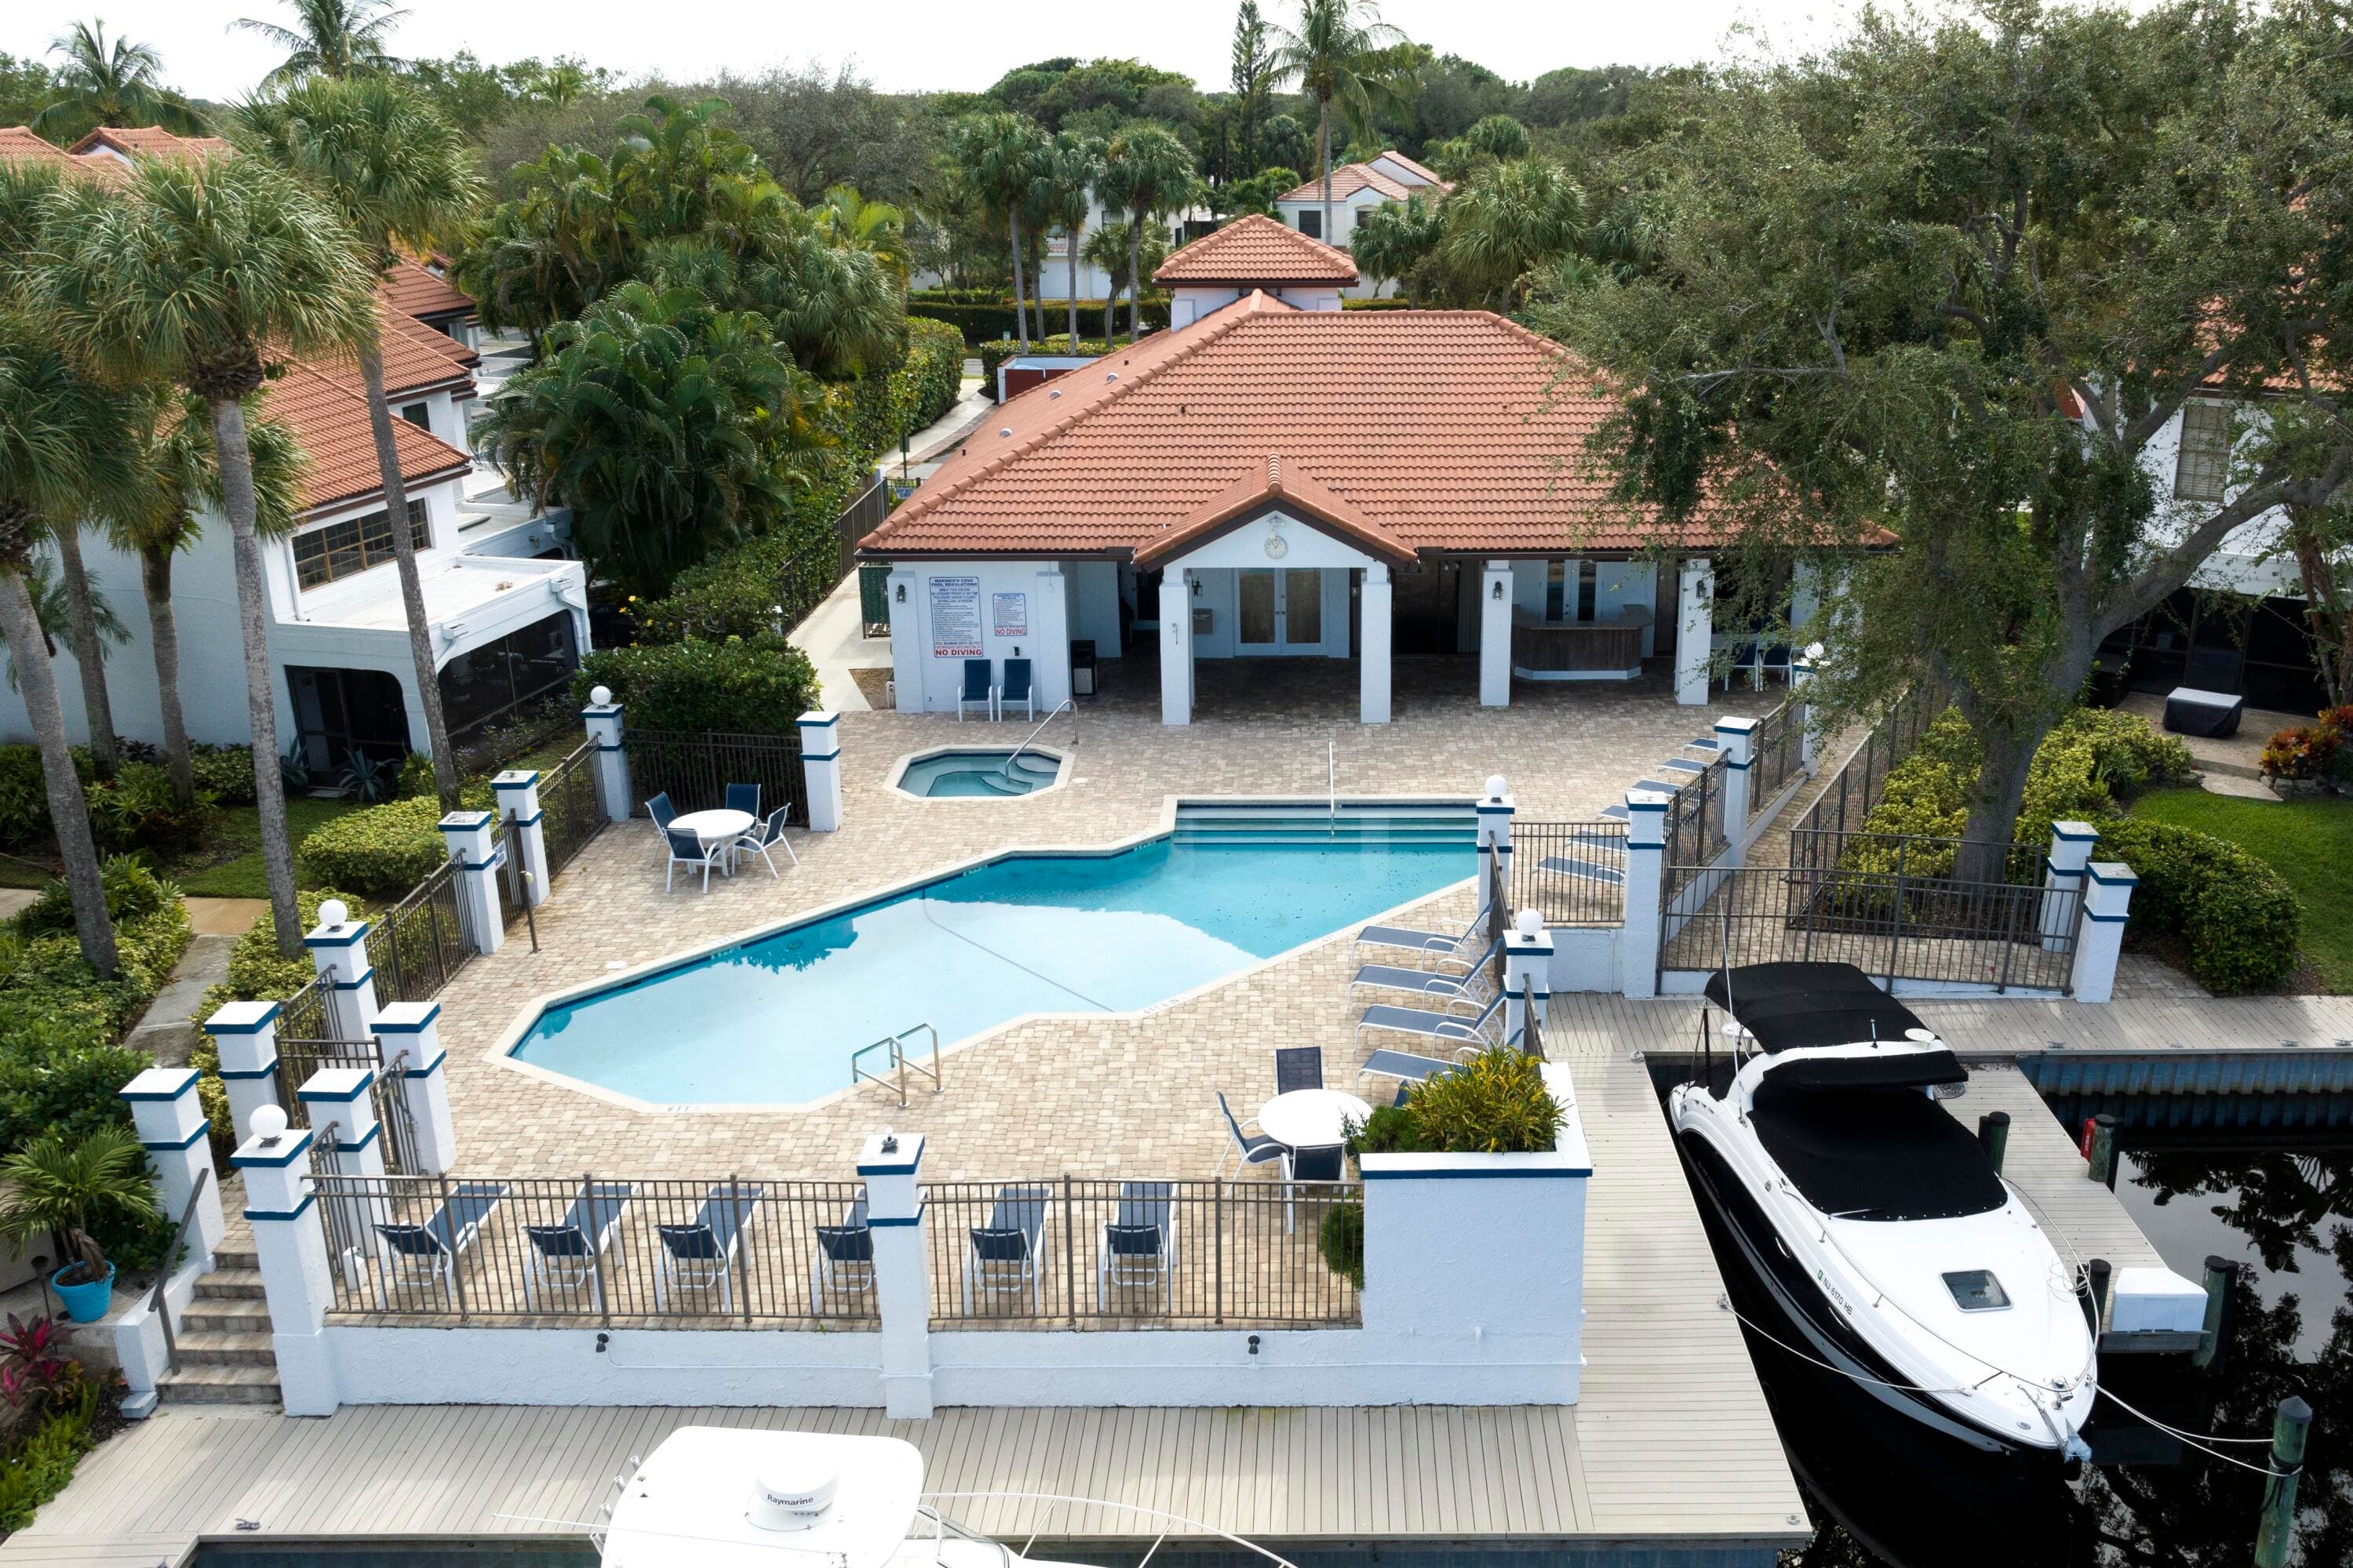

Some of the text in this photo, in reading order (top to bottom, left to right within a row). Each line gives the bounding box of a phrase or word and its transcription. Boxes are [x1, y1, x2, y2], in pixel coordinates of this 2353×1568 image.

[1823, 1277, 1853, 1315] NJ 6170 HB
[767, 1493, 814, 1506] Raymarine
